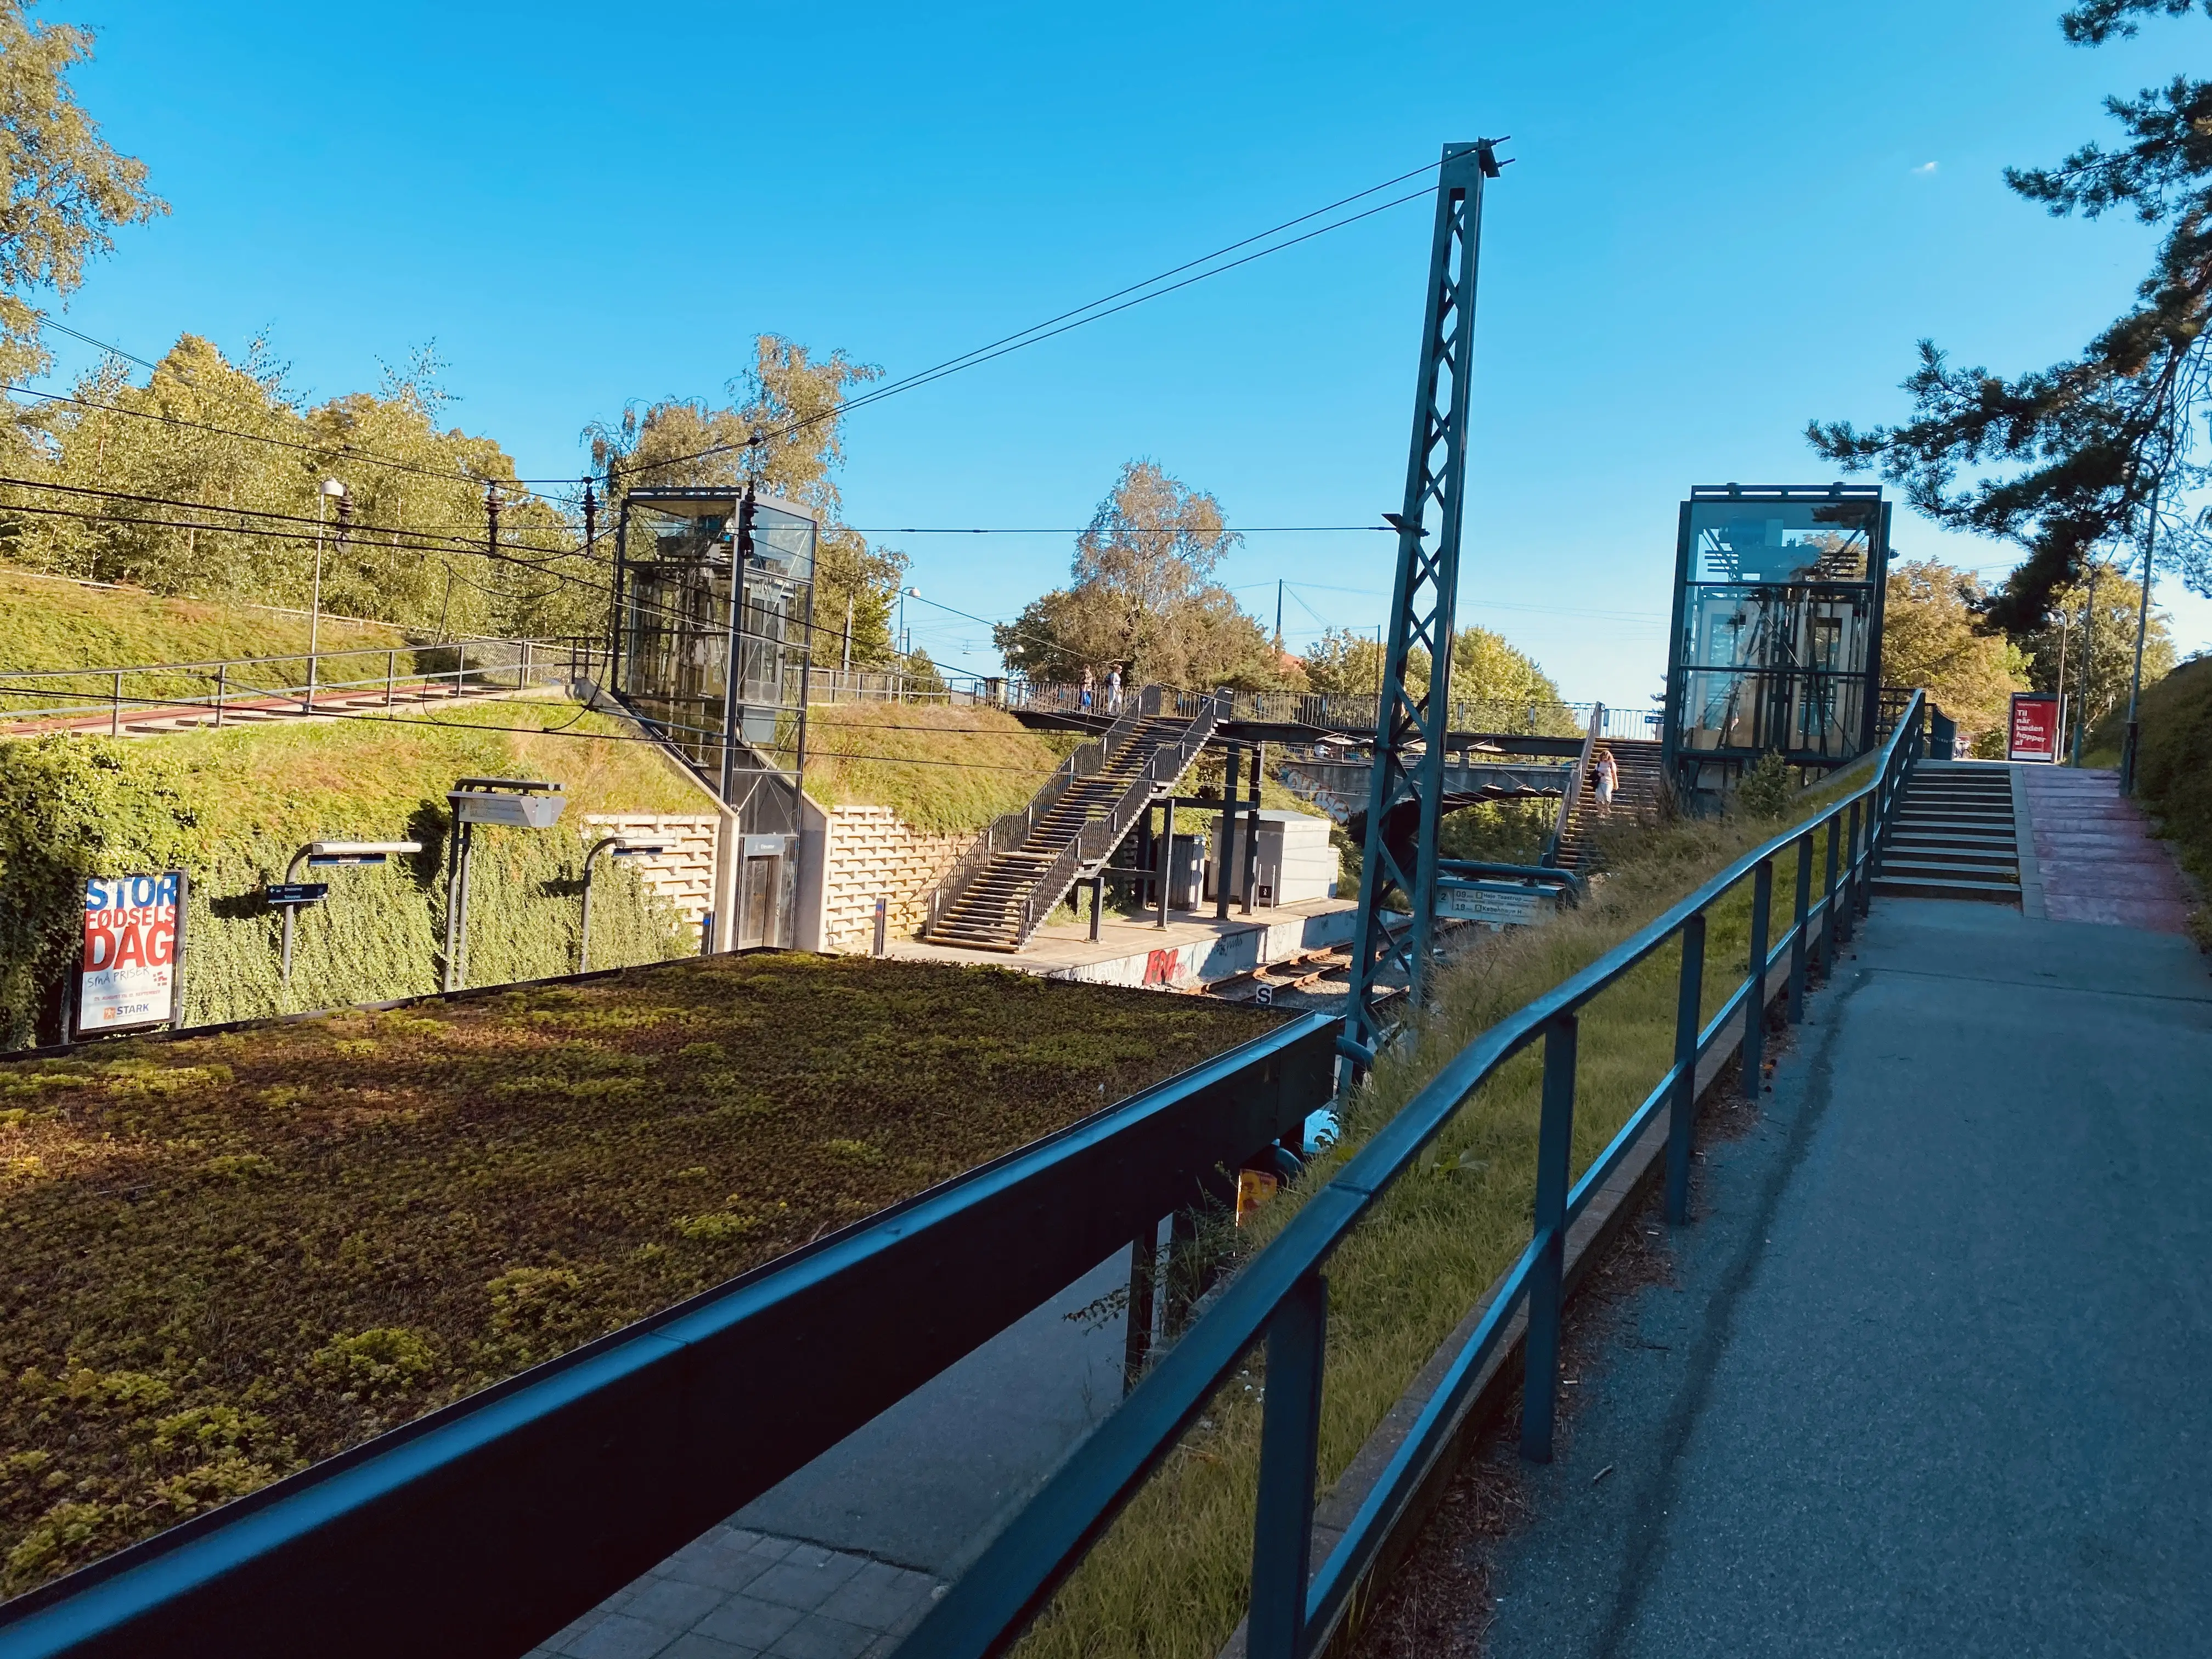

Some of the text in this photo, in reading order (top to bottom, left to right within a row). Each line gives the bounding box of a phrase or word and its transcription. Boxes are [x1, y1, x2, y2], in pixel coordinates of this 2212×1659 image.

[2017, 731, 2046, 742] hopper
[86, 876, 177, 911] STOR
[86, 905, 176, 929] FØDSELS
[84, 923, 175, 972] DAG
[114, 966, 150, 982] PRISER
[1257, 988, 1270, 1003] S
[117, 1003, 149, 1015] STARK
